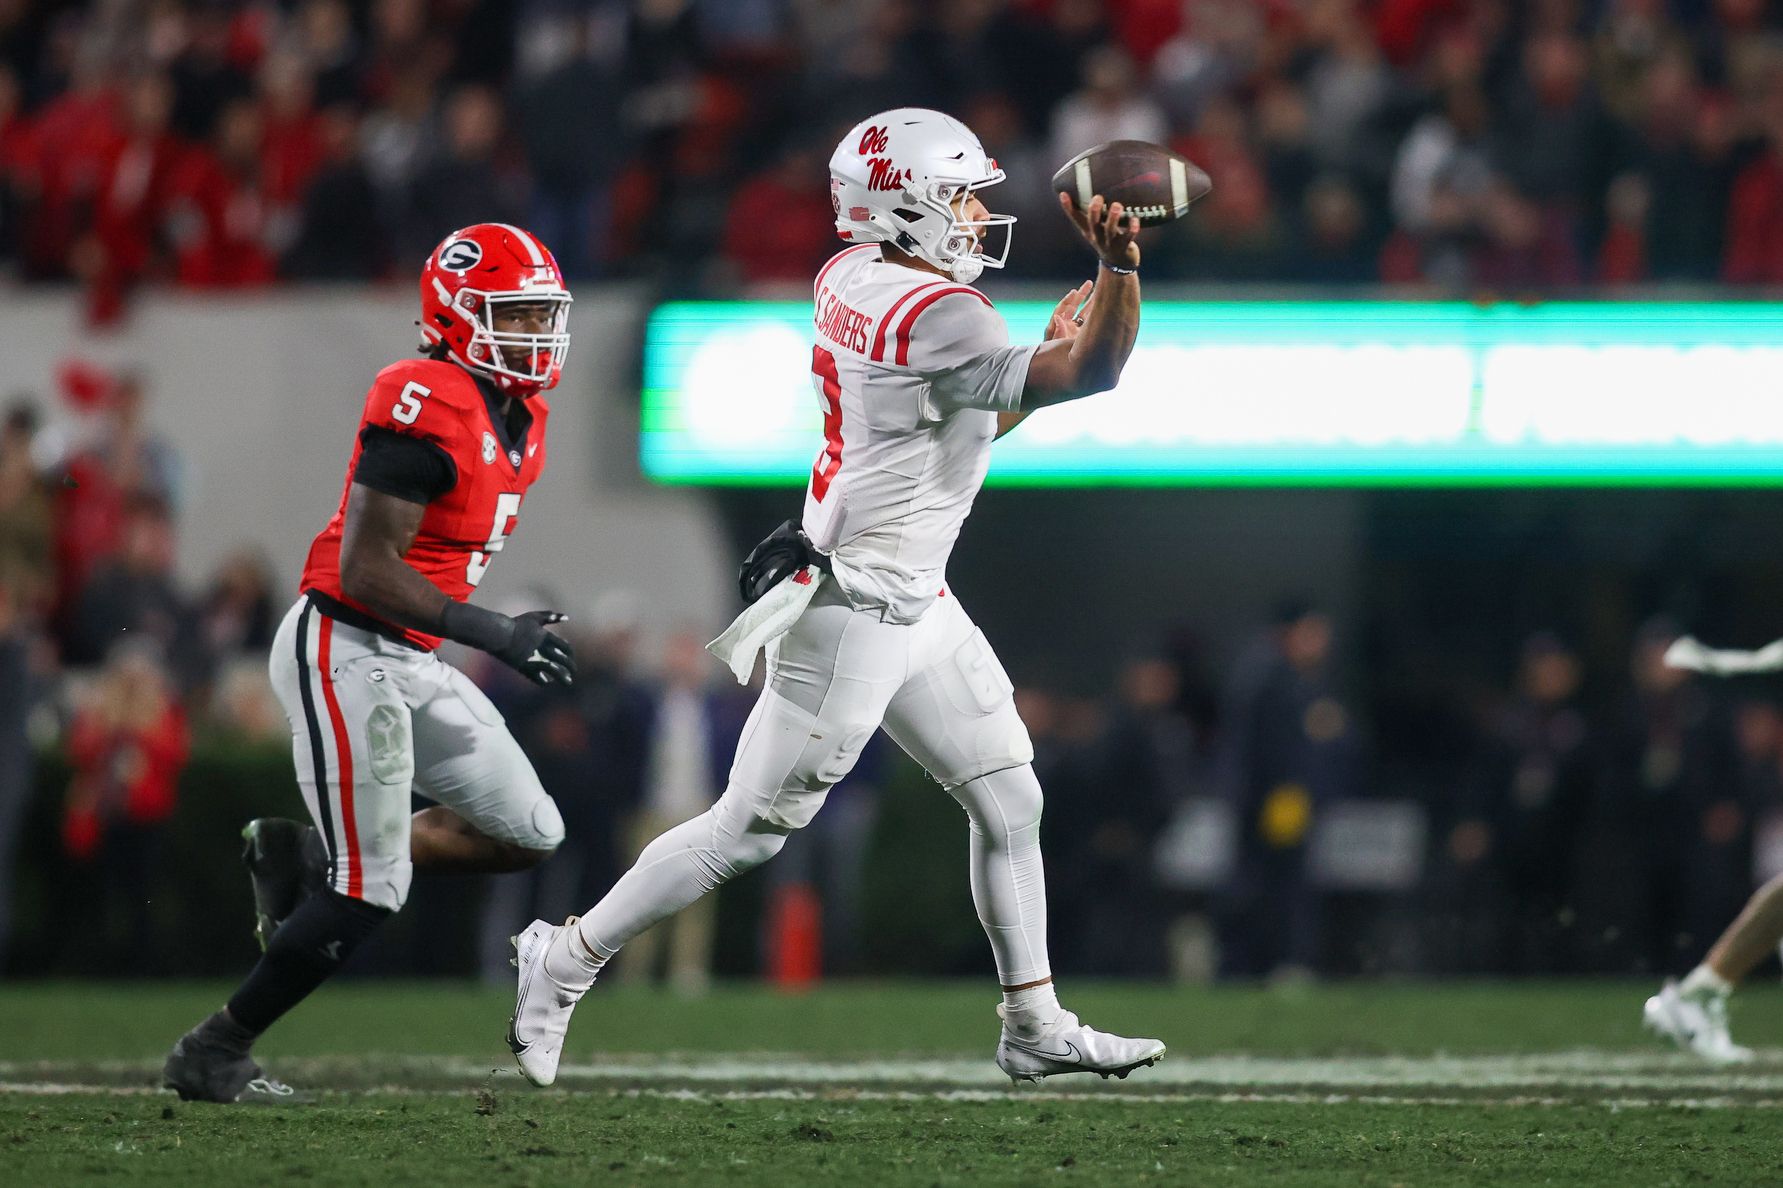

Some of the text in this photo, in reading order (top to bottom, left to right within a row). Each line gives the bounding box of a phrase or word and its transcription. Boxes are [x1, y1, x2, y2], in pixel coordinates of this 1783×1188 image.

[859, 126, 888, 155] Ole
[440, 240, 481, 271] G
[818, 294, 873, 354] SANDERS
[391, 380, 433, 425] 5
[510, 451, 521, 466] G
[466, 492, 522, 587] 5
